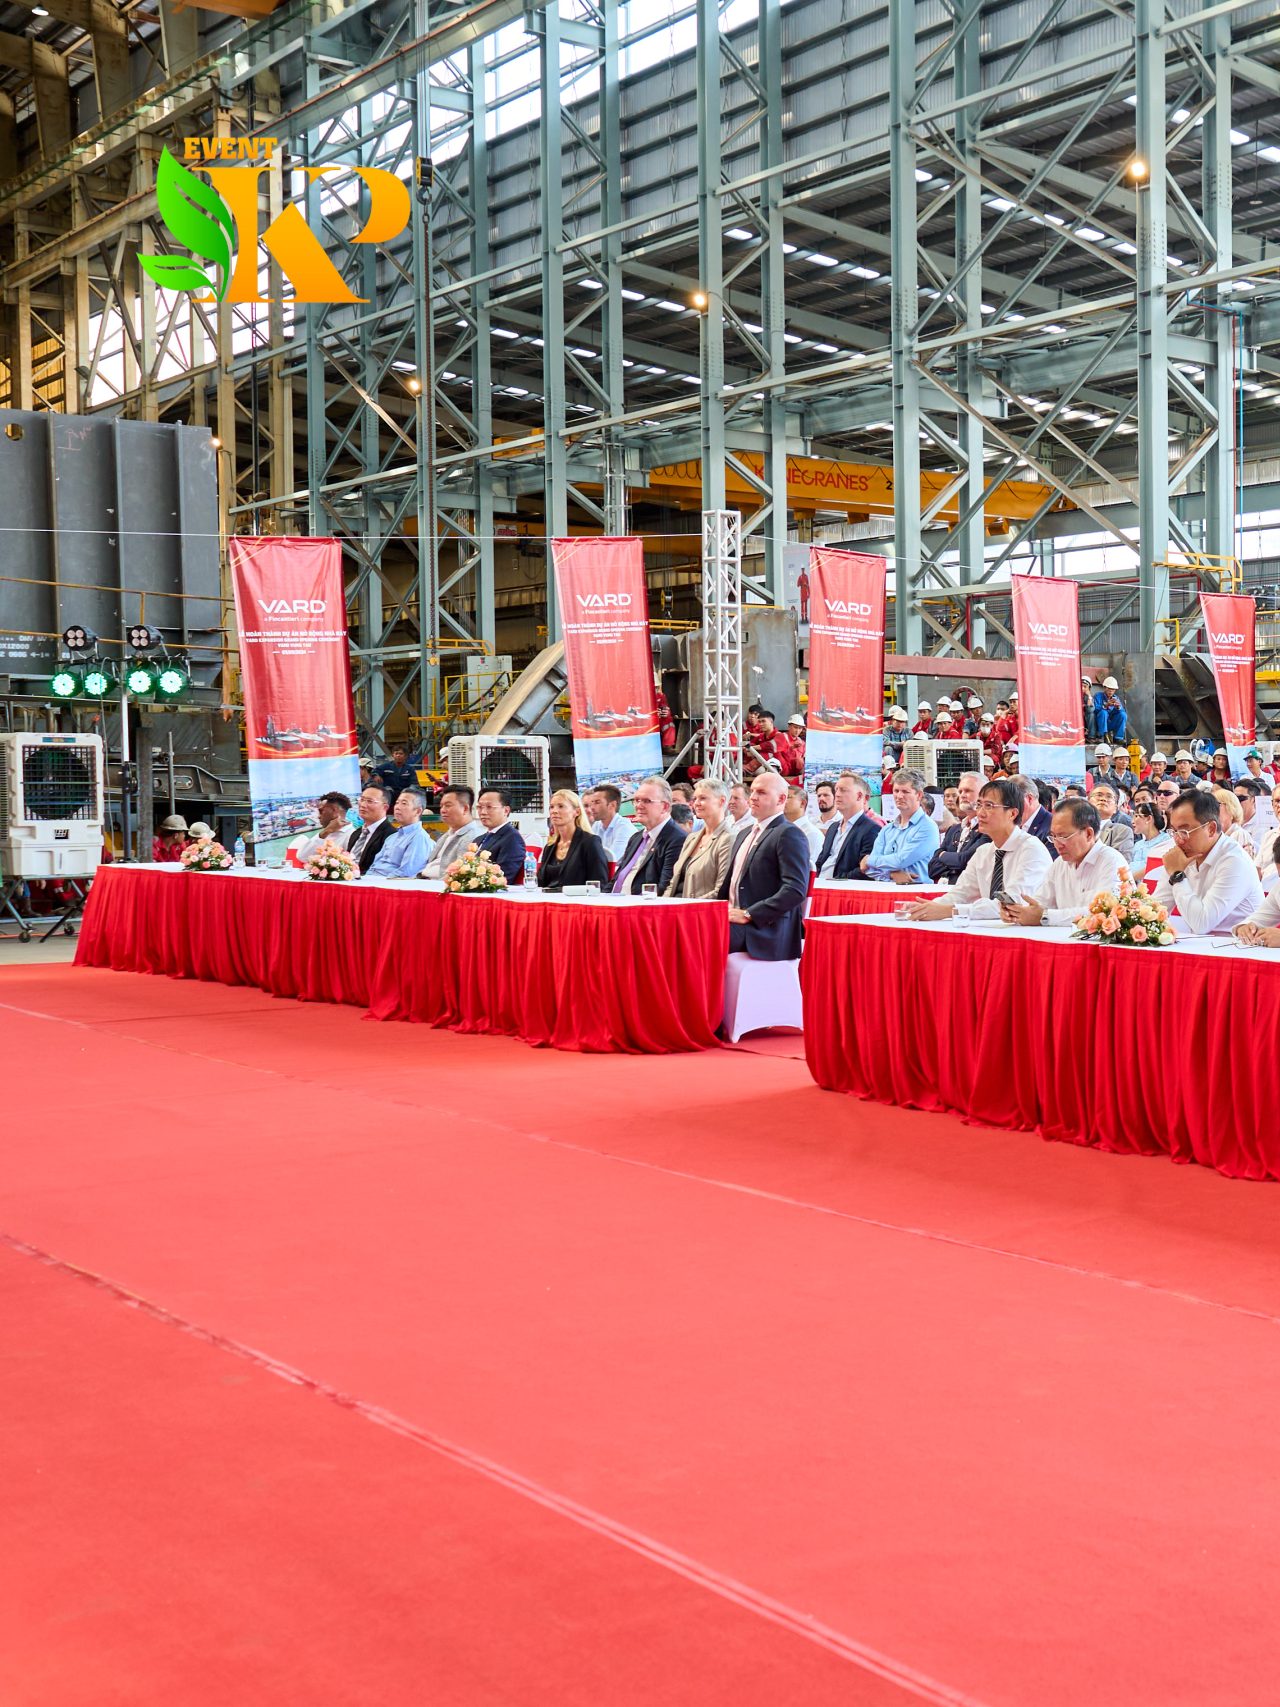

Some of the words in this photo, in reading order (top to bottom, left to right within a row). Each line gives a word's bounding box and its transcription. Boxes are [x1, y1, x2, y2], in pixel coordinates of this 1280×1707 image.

[257, 599, 326, 614] VARD
[576, 593, 632, 607] VARD
[824, 599, 871, 616] VARD
[1027, 622, 1067, 636] VARD
[1211, 632, 1244, 645] VARD
